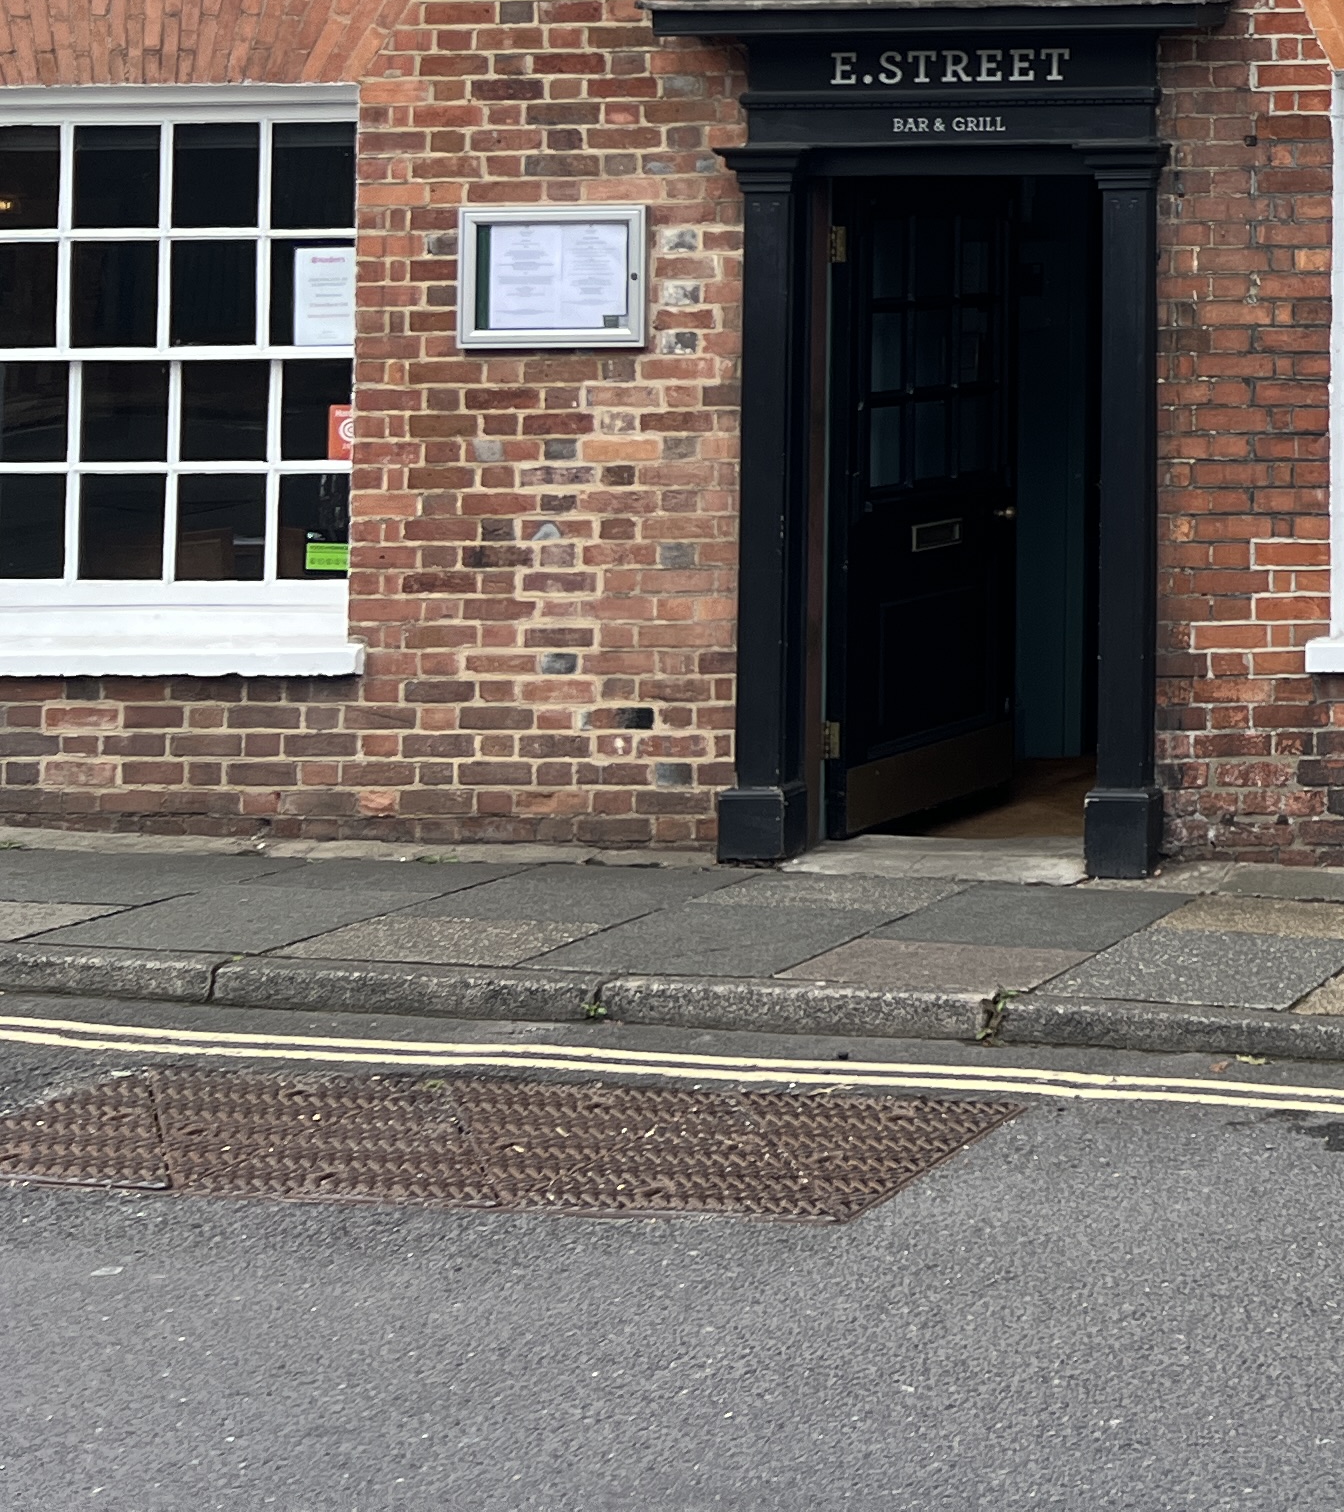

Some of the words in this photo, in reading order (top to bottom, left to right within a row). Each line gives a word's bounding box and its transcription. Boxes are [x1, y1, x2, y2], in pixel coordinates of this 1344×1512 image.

[830, 48, 1070, 85] E.STREET
[892, 117, 930, 132] BAR
[933, 117, 946, 132] &
[952, 116, 1006, 132] GRILL
